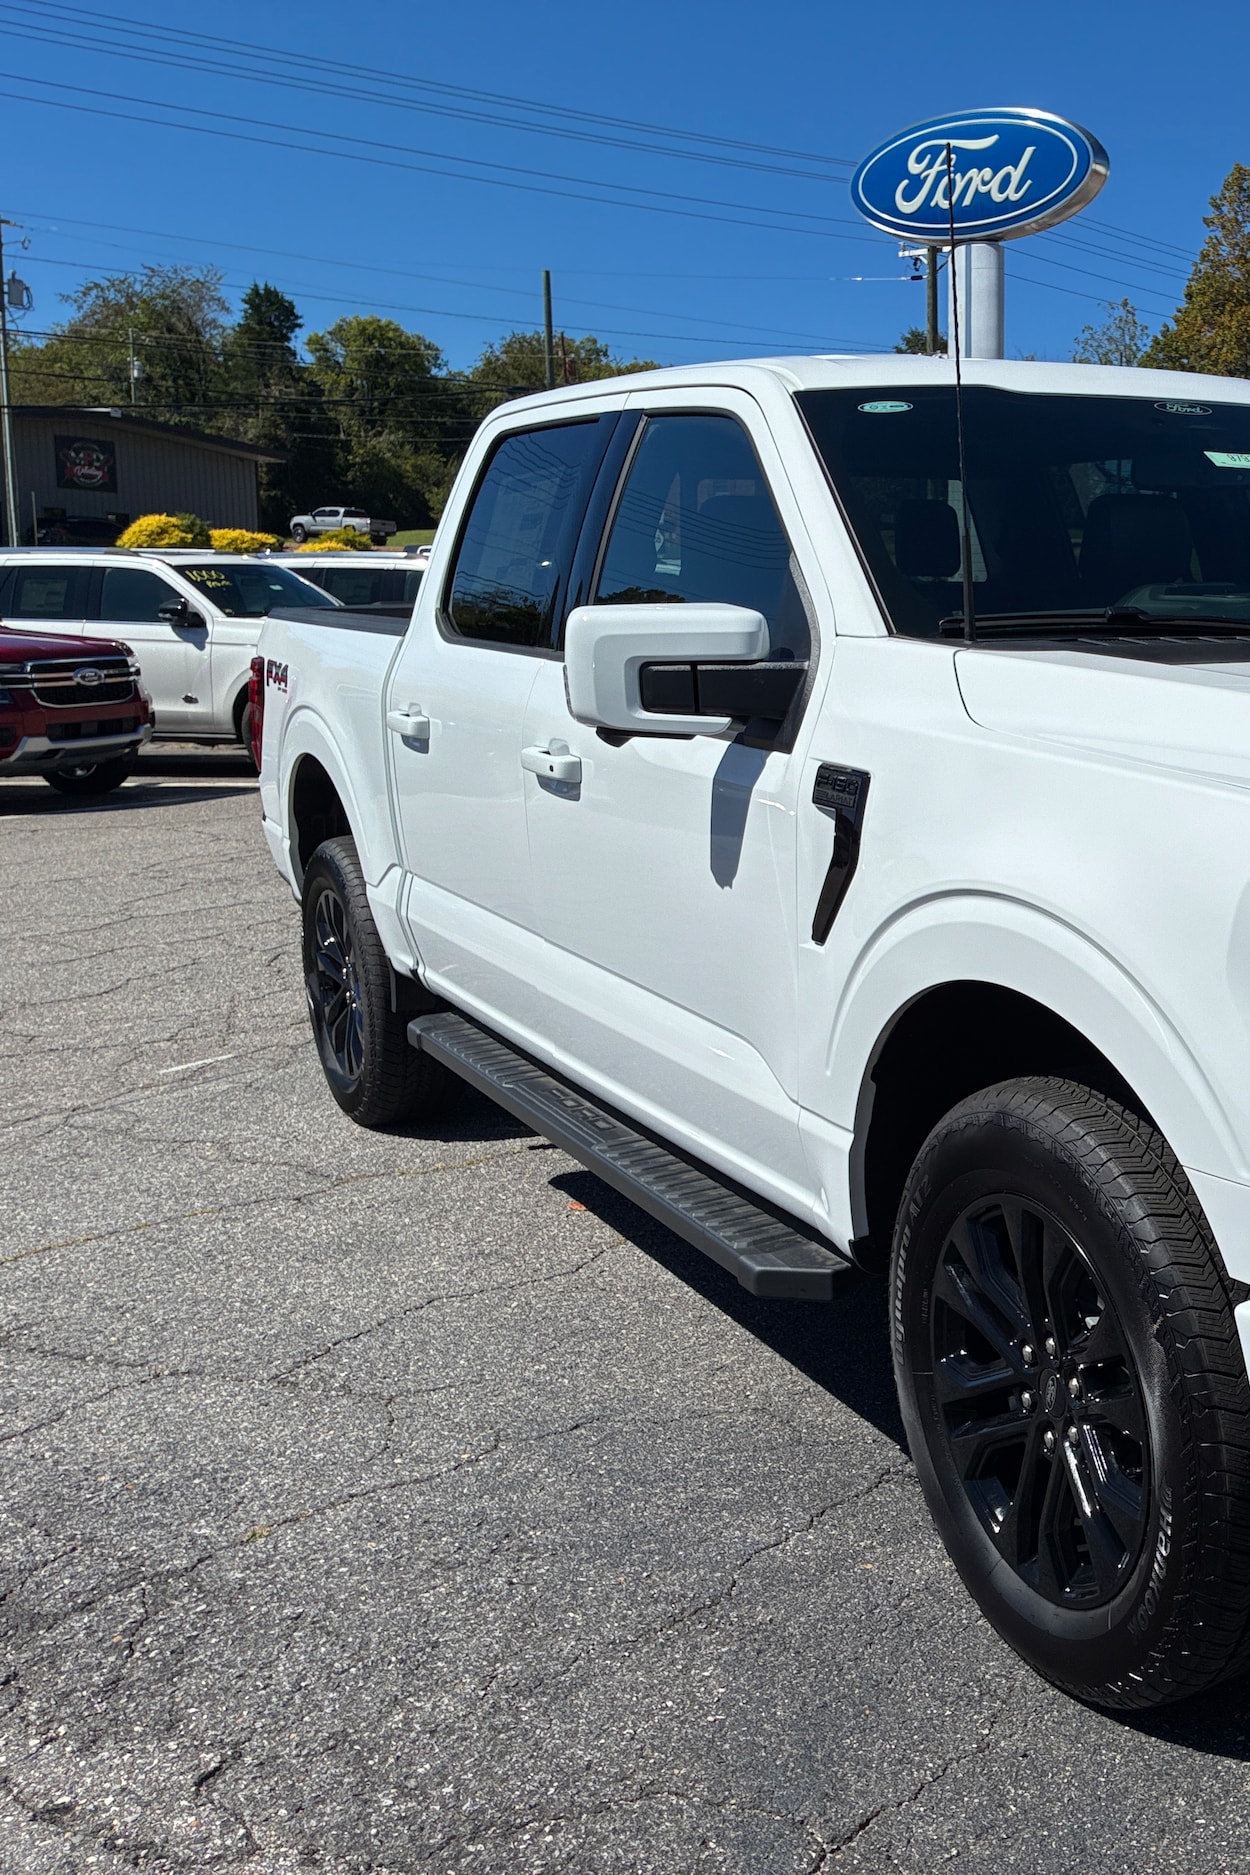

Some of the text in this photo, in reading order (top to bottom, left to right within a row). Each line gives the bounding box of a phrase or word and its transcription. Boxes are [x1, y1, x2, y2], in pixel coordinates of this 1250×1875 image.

[894, 134, 1037, 214] Ford
[1166, 402, 1204, 414] Ford
[267, 659, 288, 688] FX4
[817, 772, 859, 796] F-150
[825, 790, 853, 806] LARIAT
[538, 1087, 617, 1132] FORD
